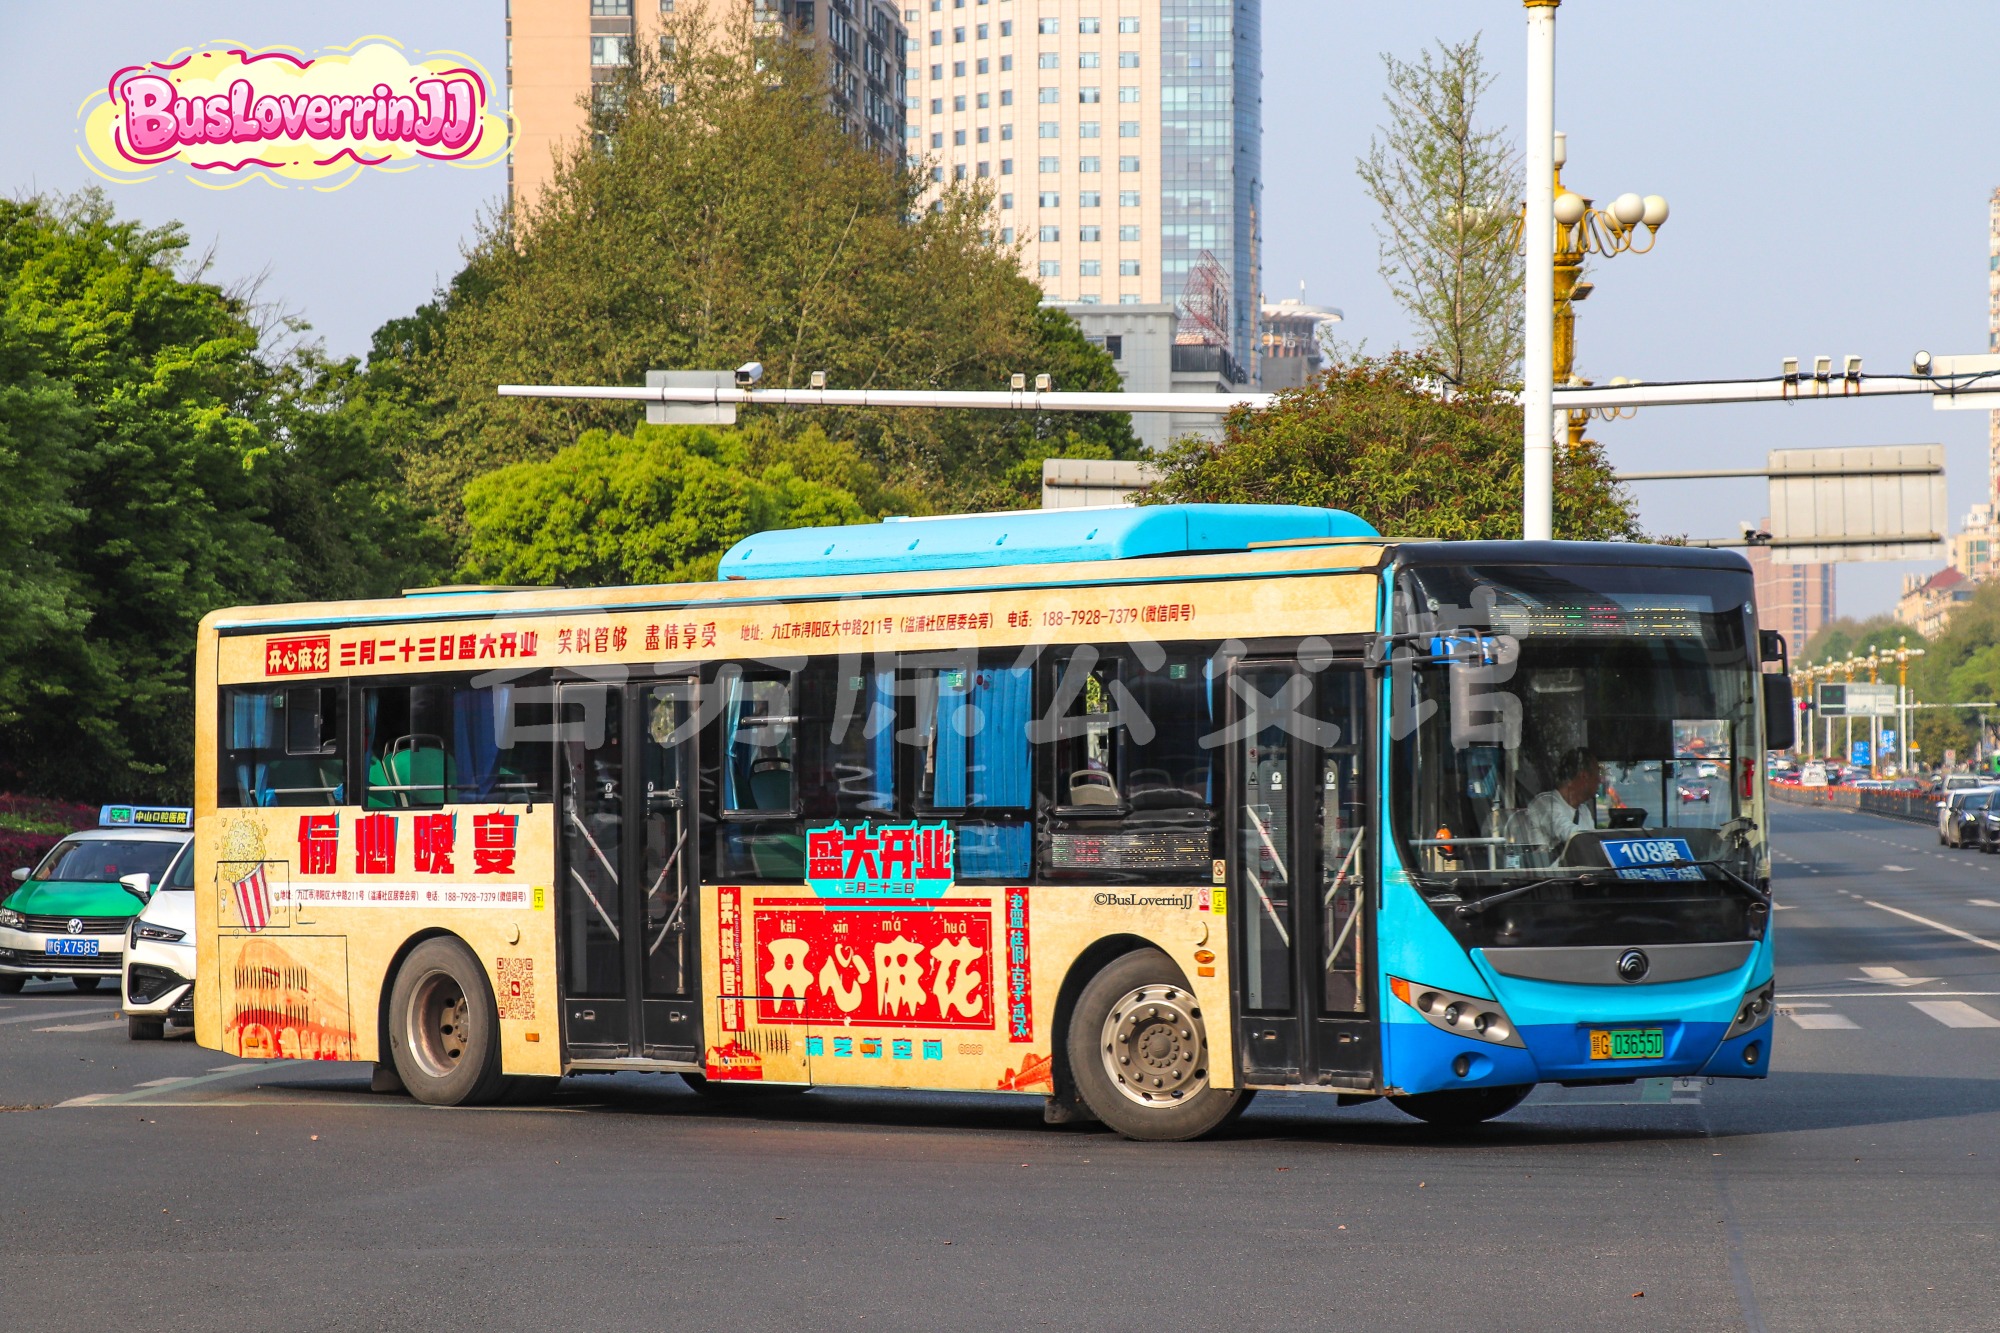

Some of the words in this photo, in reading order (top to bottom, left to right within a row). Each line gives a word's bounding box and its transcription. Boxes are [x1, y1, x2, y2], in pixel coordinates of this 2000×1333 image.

[340, 630, 538, 667] 三月二十三日盛大开业
[558, 625, 628, 655] 笑料管够
[645, 621, 717, 651] 盡情享受
[267, 645, 328, 674] 开心麻花
[136, 811, 187, 824] 中山口腔医院
[806, 821, 953, 880] 盛大开业
[1620, 841, 1681, 864] 108路
[844, 882, 915, 894] 三月二十三日
[720, 892, 738, 1030] 笑料管够
[765, 935, 984, 1019] 开心麻花
